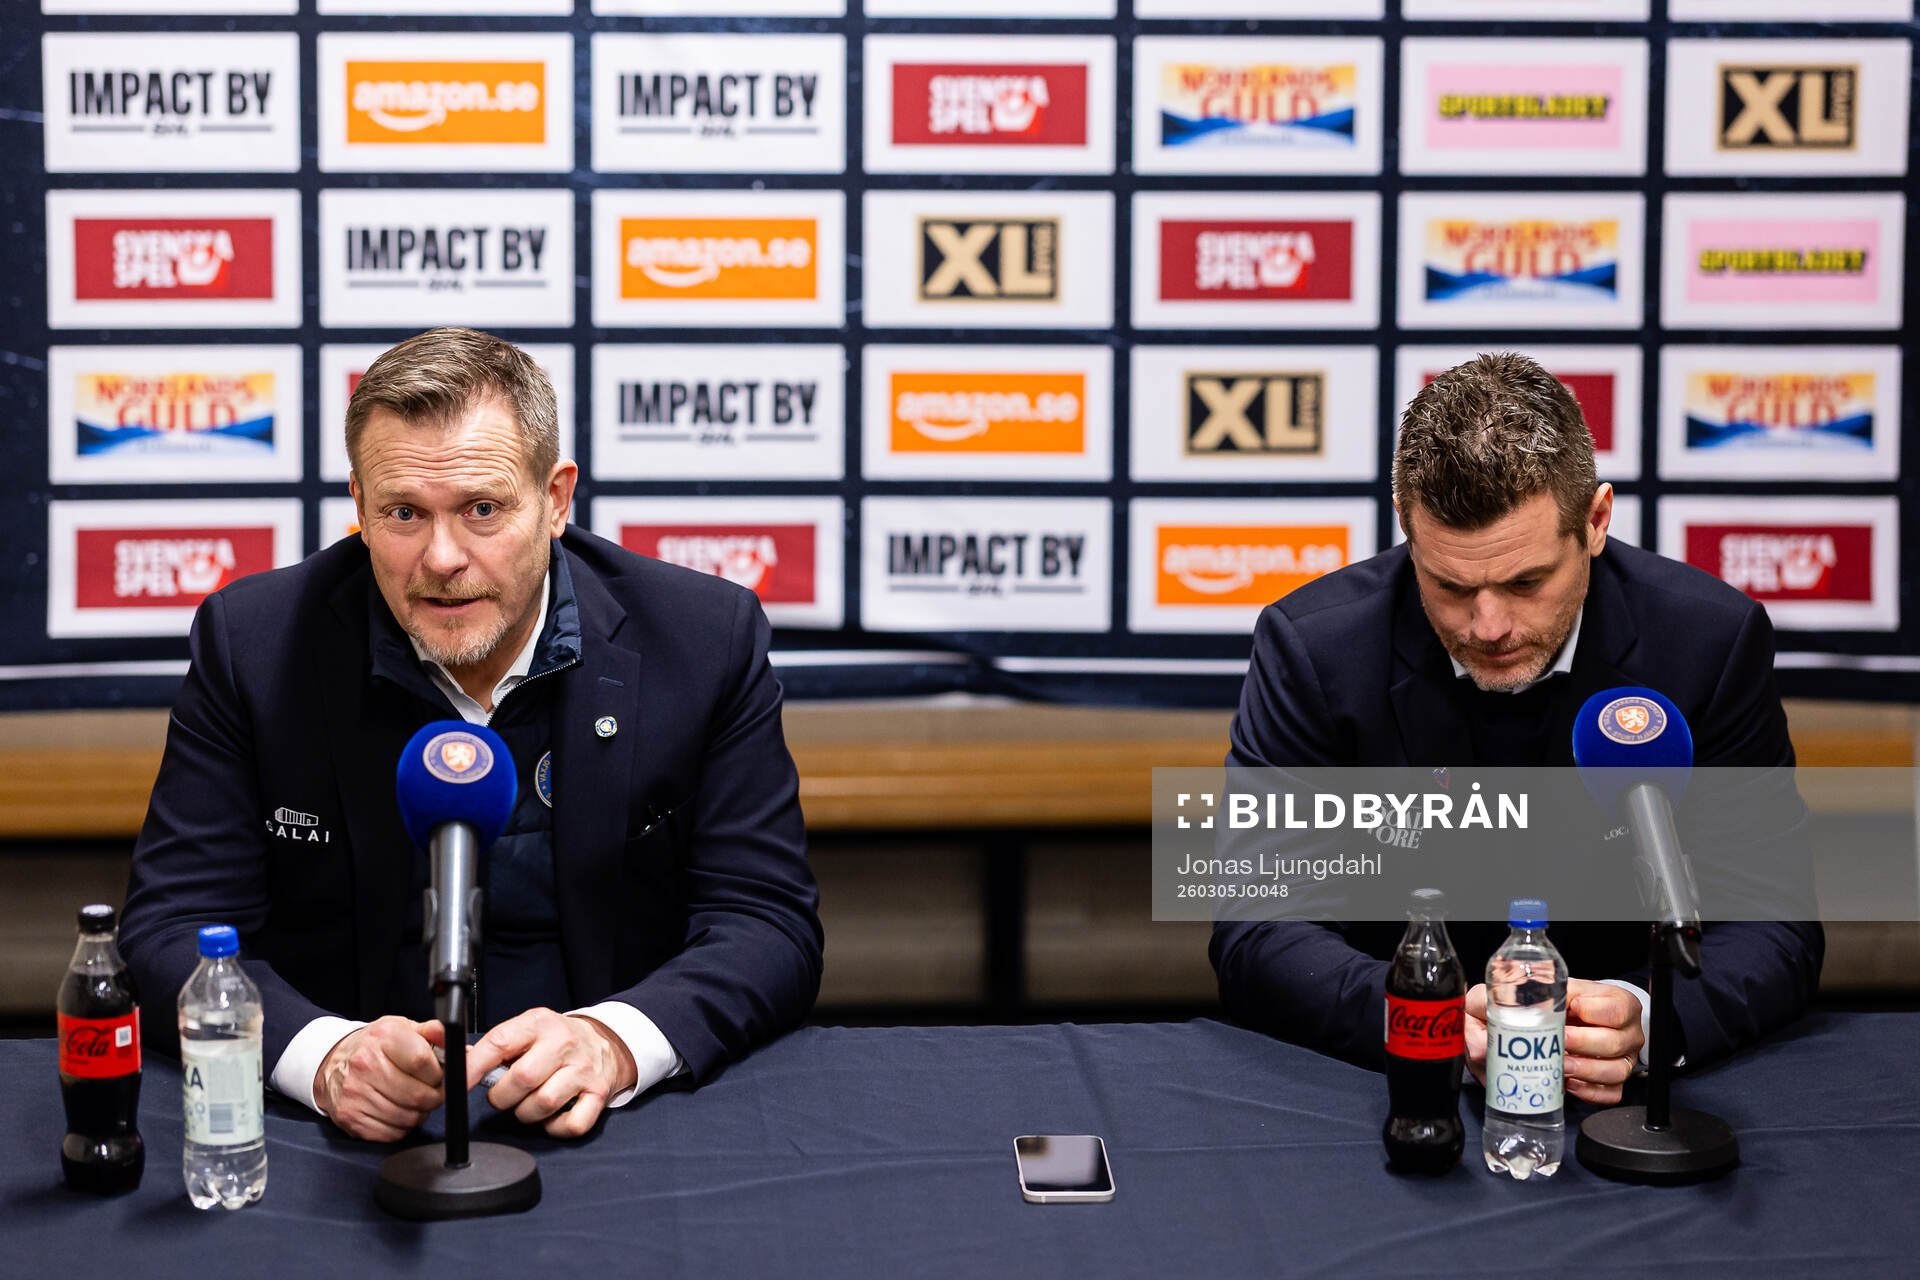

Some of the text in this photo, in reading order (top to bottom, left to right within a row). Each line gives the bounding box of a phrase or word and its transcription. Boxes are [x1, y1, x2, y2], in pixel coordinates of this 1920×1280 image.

[69, 71, 272, 116] IMPACT BY
[353, 80, 539, 115] amazon.se
[618, 74, 818, 118] IMPACT BY
[1726, 72, 1848, 142] XL
[346, 228, 546, 271] IMPACT BY
[627, 235, 810, 270] amazon.se
[926, 224, 1052, 295] XL
[618, 382, 818, 425] IMPACT BY
[897, 390, 1078, 425] amazon.se
[1192, 379, 1316, 448] XL
[886, 533, 1086, 578] IMPACT BY
[1163, 544, 1343, 577] amazon.se
[1497, 1033, 1561, 1061] LOKA
[1507, 1063, 1553, 1073] NATURELL
